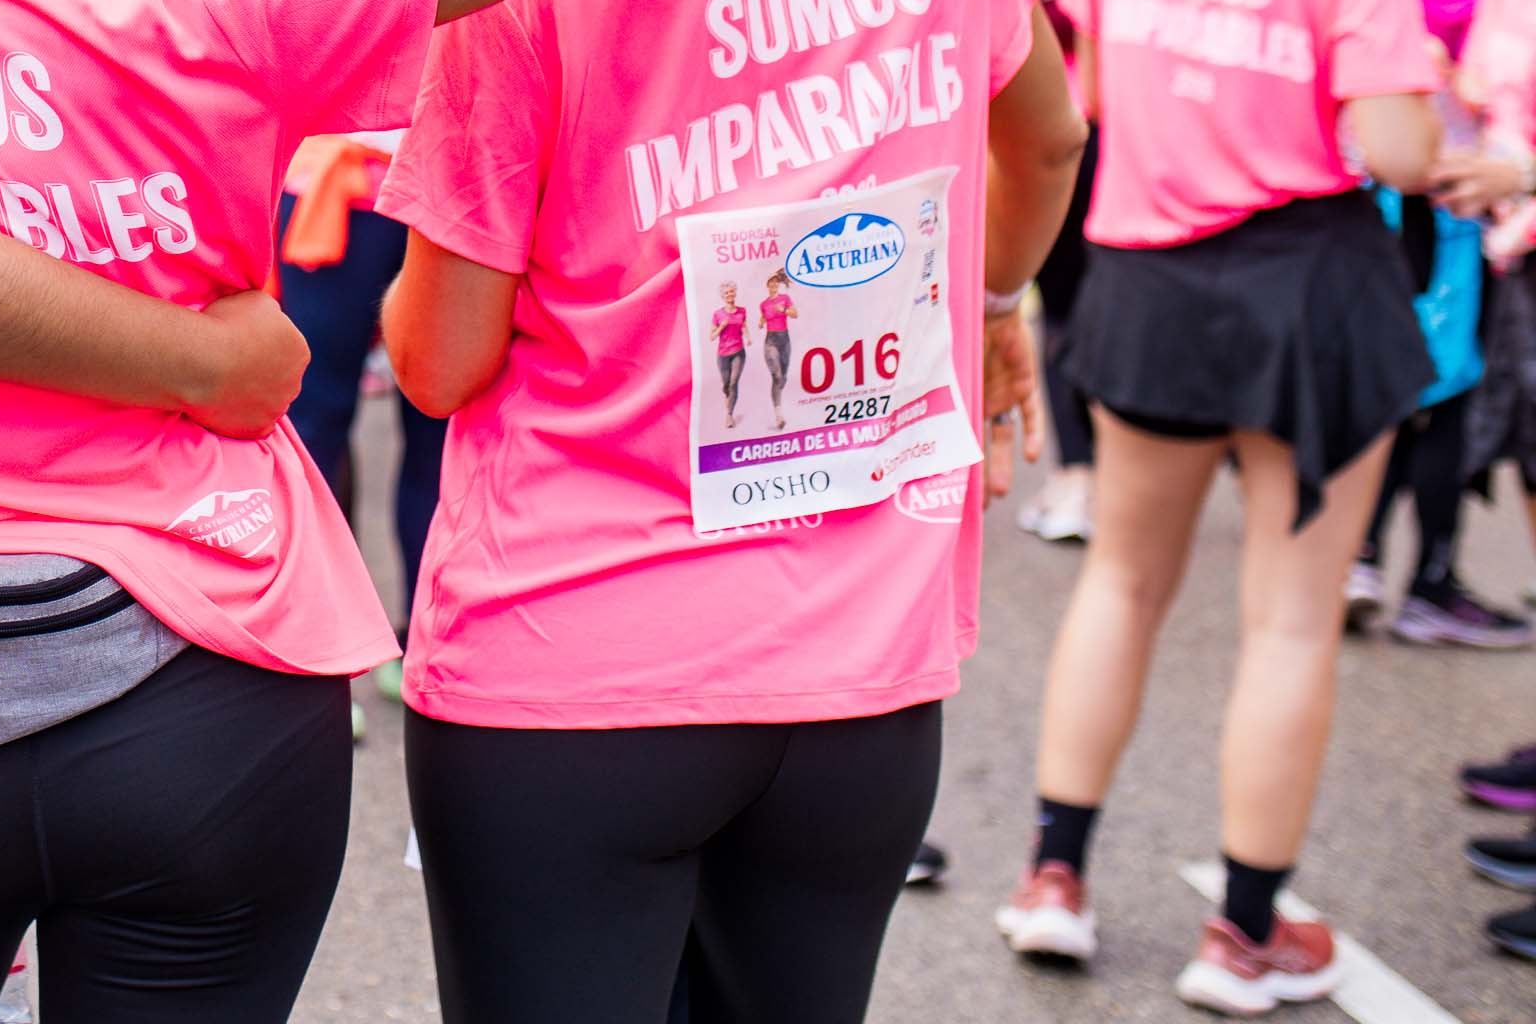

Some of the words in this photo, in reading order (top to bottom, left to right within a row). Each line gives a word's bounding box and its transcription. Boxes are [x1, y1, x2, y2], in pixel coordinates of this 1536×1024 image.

[716, 239, 780, 264] SUMA
[795, 239, 899, 276] ASTURIANA
[801, 332, 900, 394] 016
[824, 395, 891, 424] 24287
[731, 436, 802, 464] CARRERA
[805, 433, 826, 453] DE
[828, 428, 850, 449] LA
[732, 469, 831, 506] OYSHO
